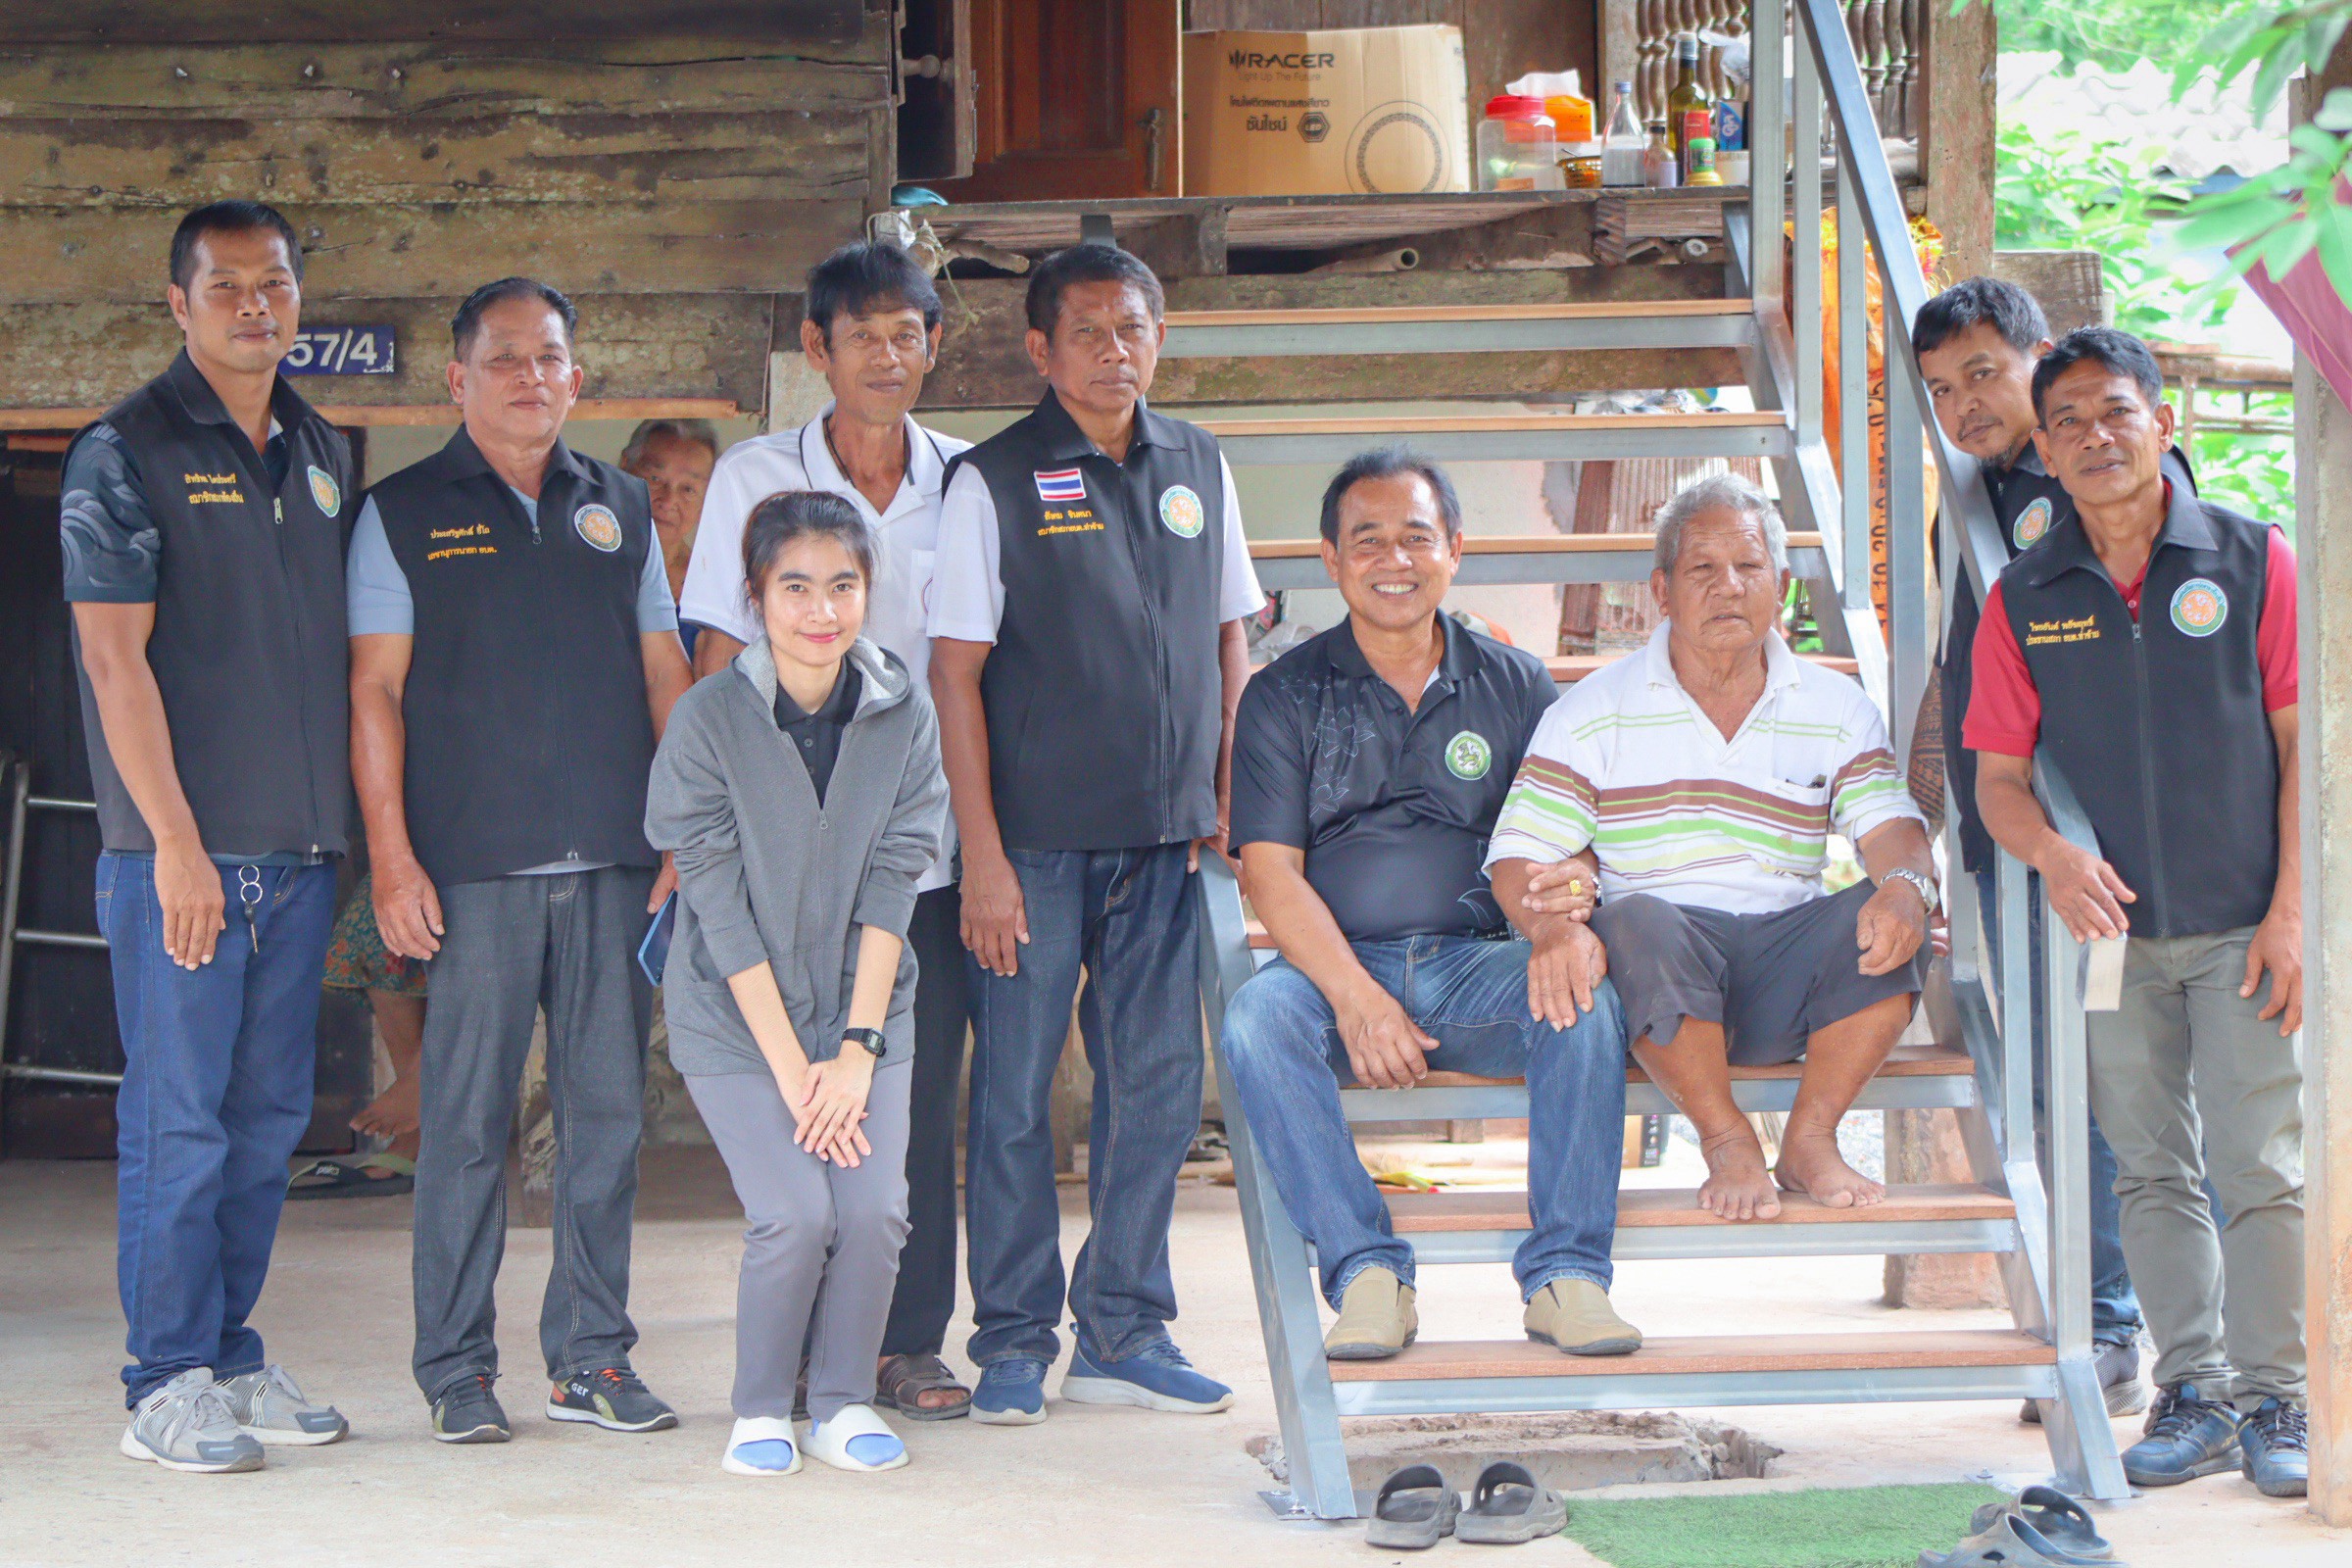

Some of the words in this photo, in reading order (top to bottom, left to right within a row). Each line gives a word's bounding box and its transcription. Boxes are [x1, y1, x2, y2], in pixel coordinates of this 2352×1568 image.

[1248, 53, 1335, 69] RACER
[1275, 72, 1291, 81] The
[286, 328, 378, 373] 57/4
